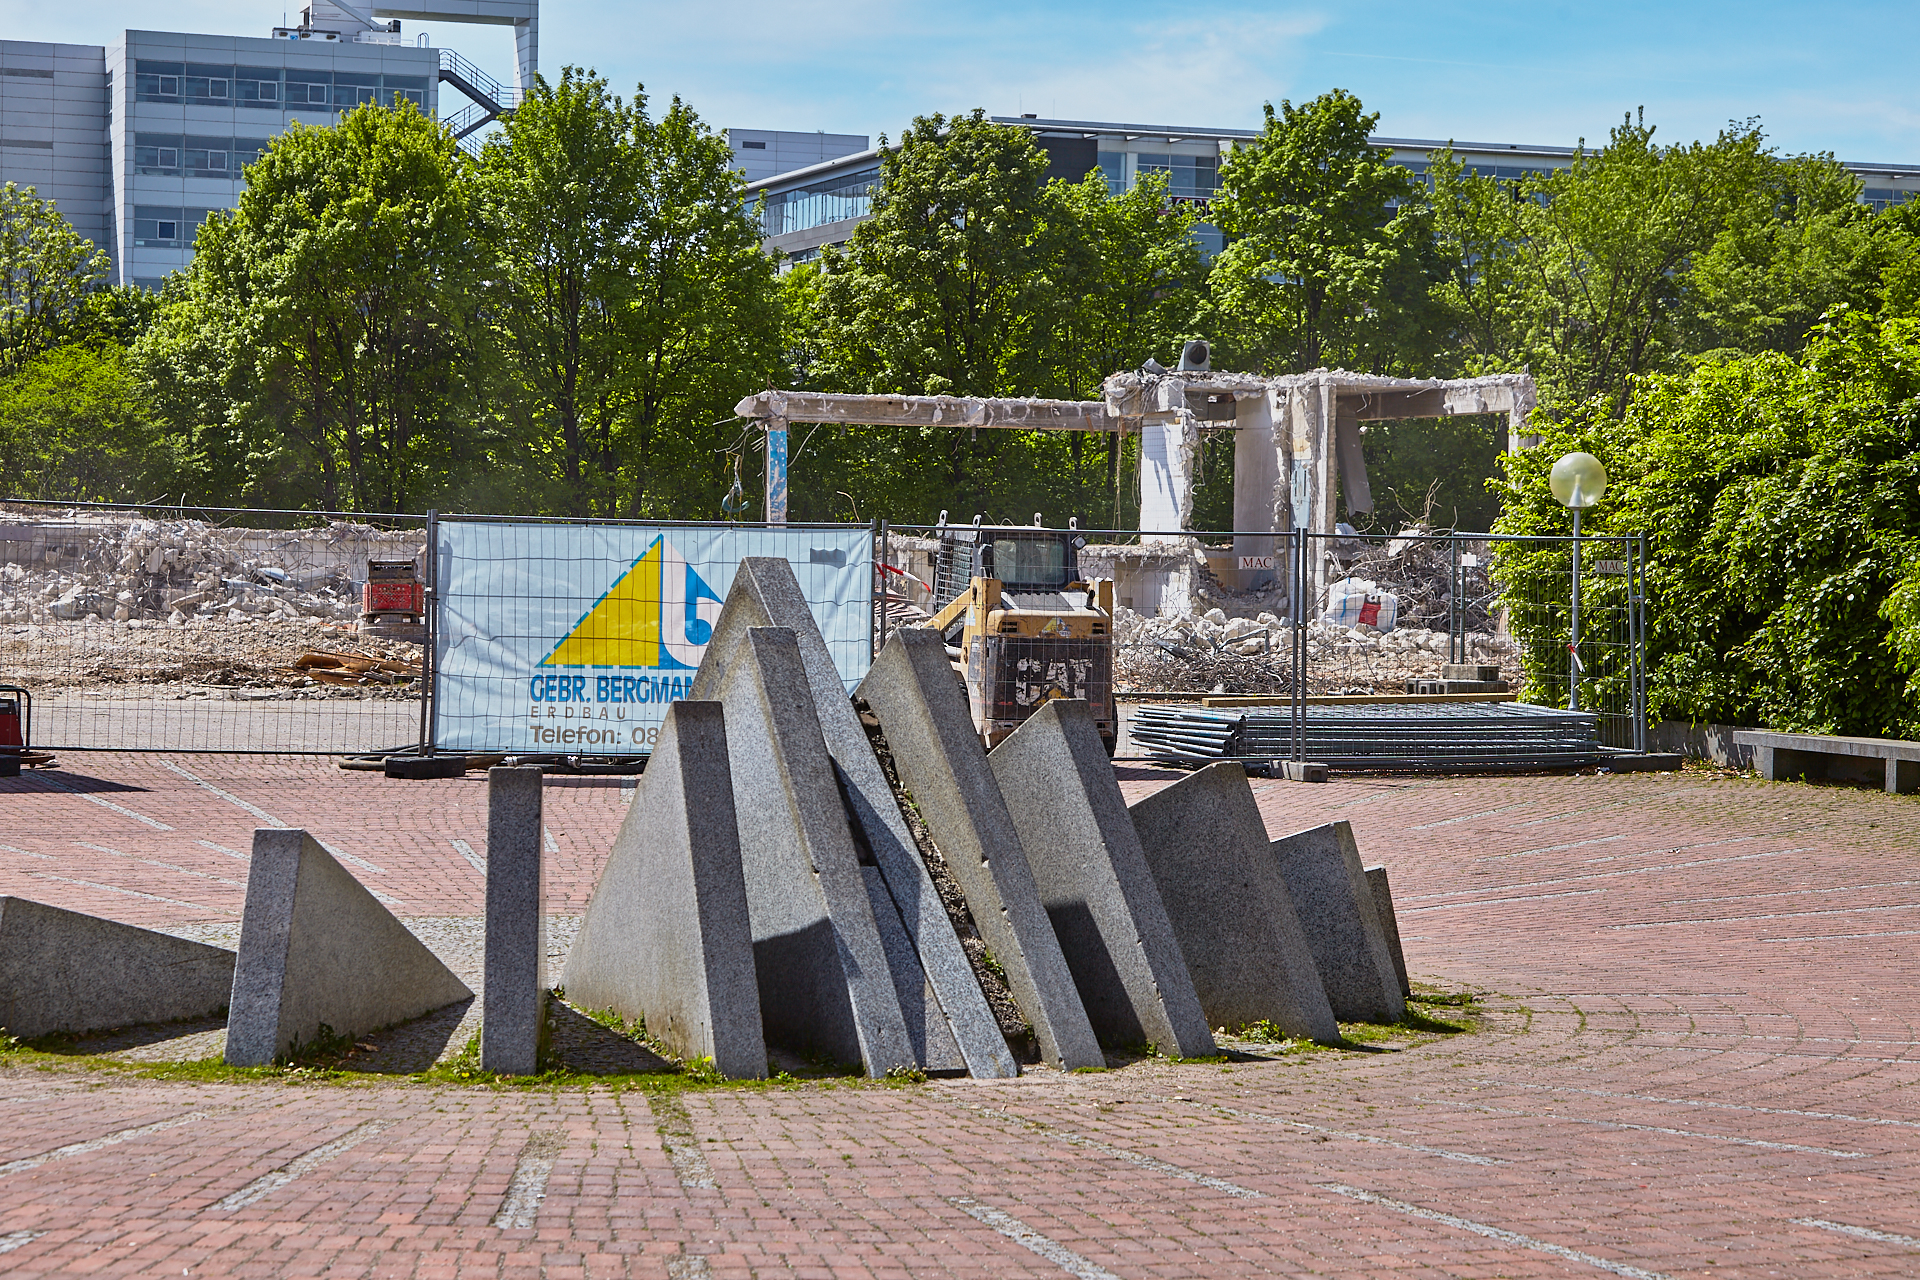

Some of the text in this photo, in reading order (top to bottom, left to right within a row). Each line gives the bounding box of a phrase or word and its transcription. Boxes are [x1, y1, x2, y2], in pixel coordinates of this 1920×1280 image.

[1243, 556, 1272, 568] MAC
[1598, 560, 1622, 572] MAC
[530, 674, 591, 703] GEBR.
[530, 706, 626, 719] ERDBAU
[530, 725, 622, 745] Telefon:
